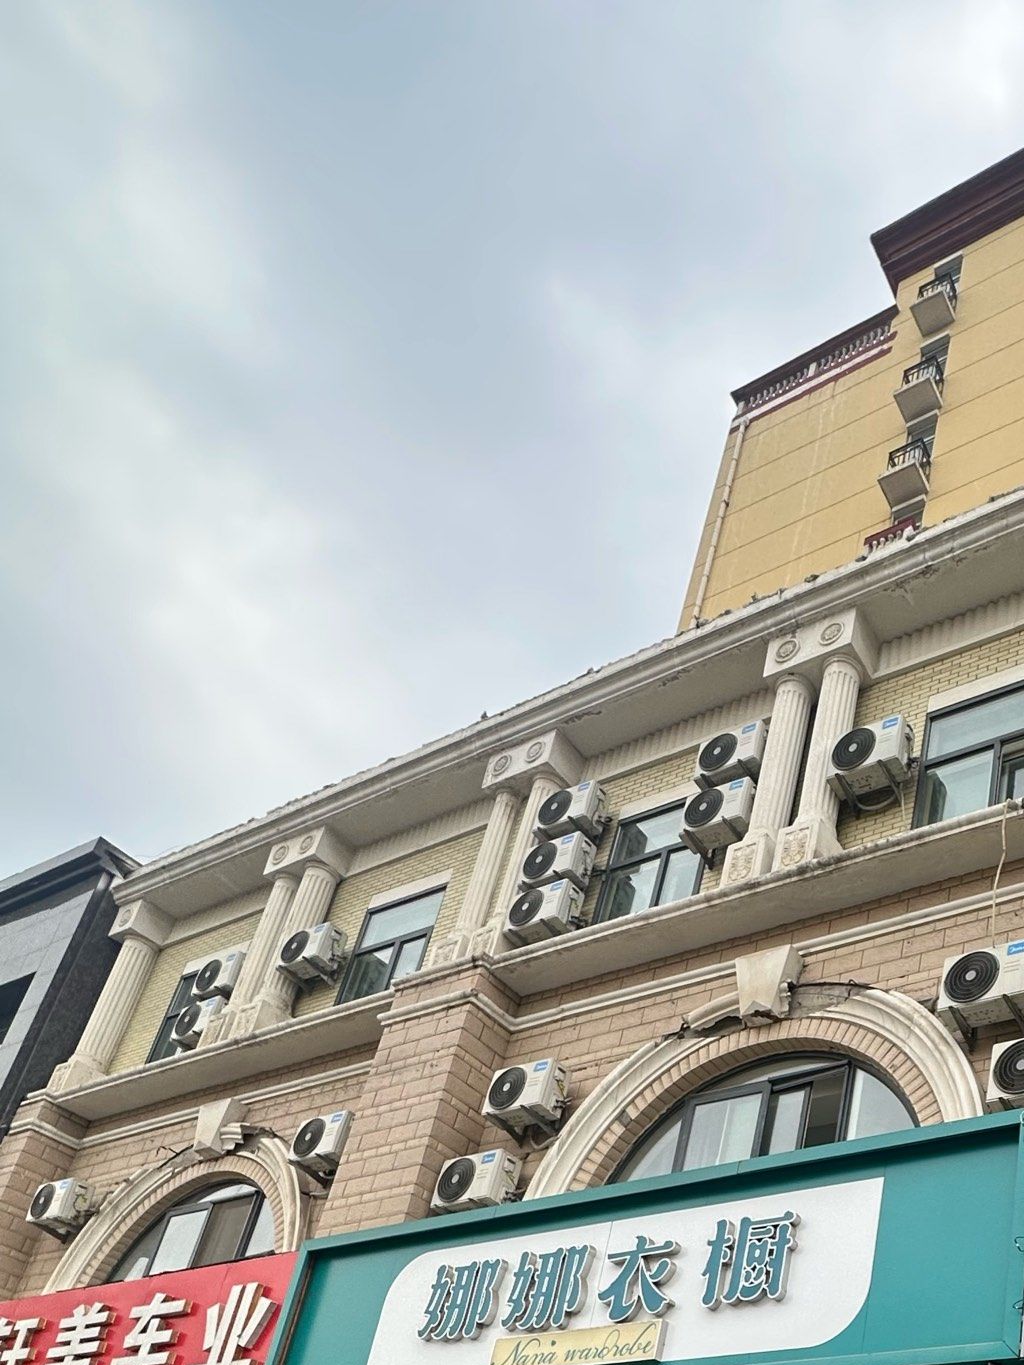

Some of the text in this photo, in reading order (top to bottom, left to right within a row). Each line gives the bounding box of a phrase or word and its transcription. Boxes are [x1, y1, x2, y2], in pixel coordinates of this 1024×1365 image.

[416, 1210, 801, 1342] 娜娜衣橱
[563, 1323, 657, 1363] wardrobe
